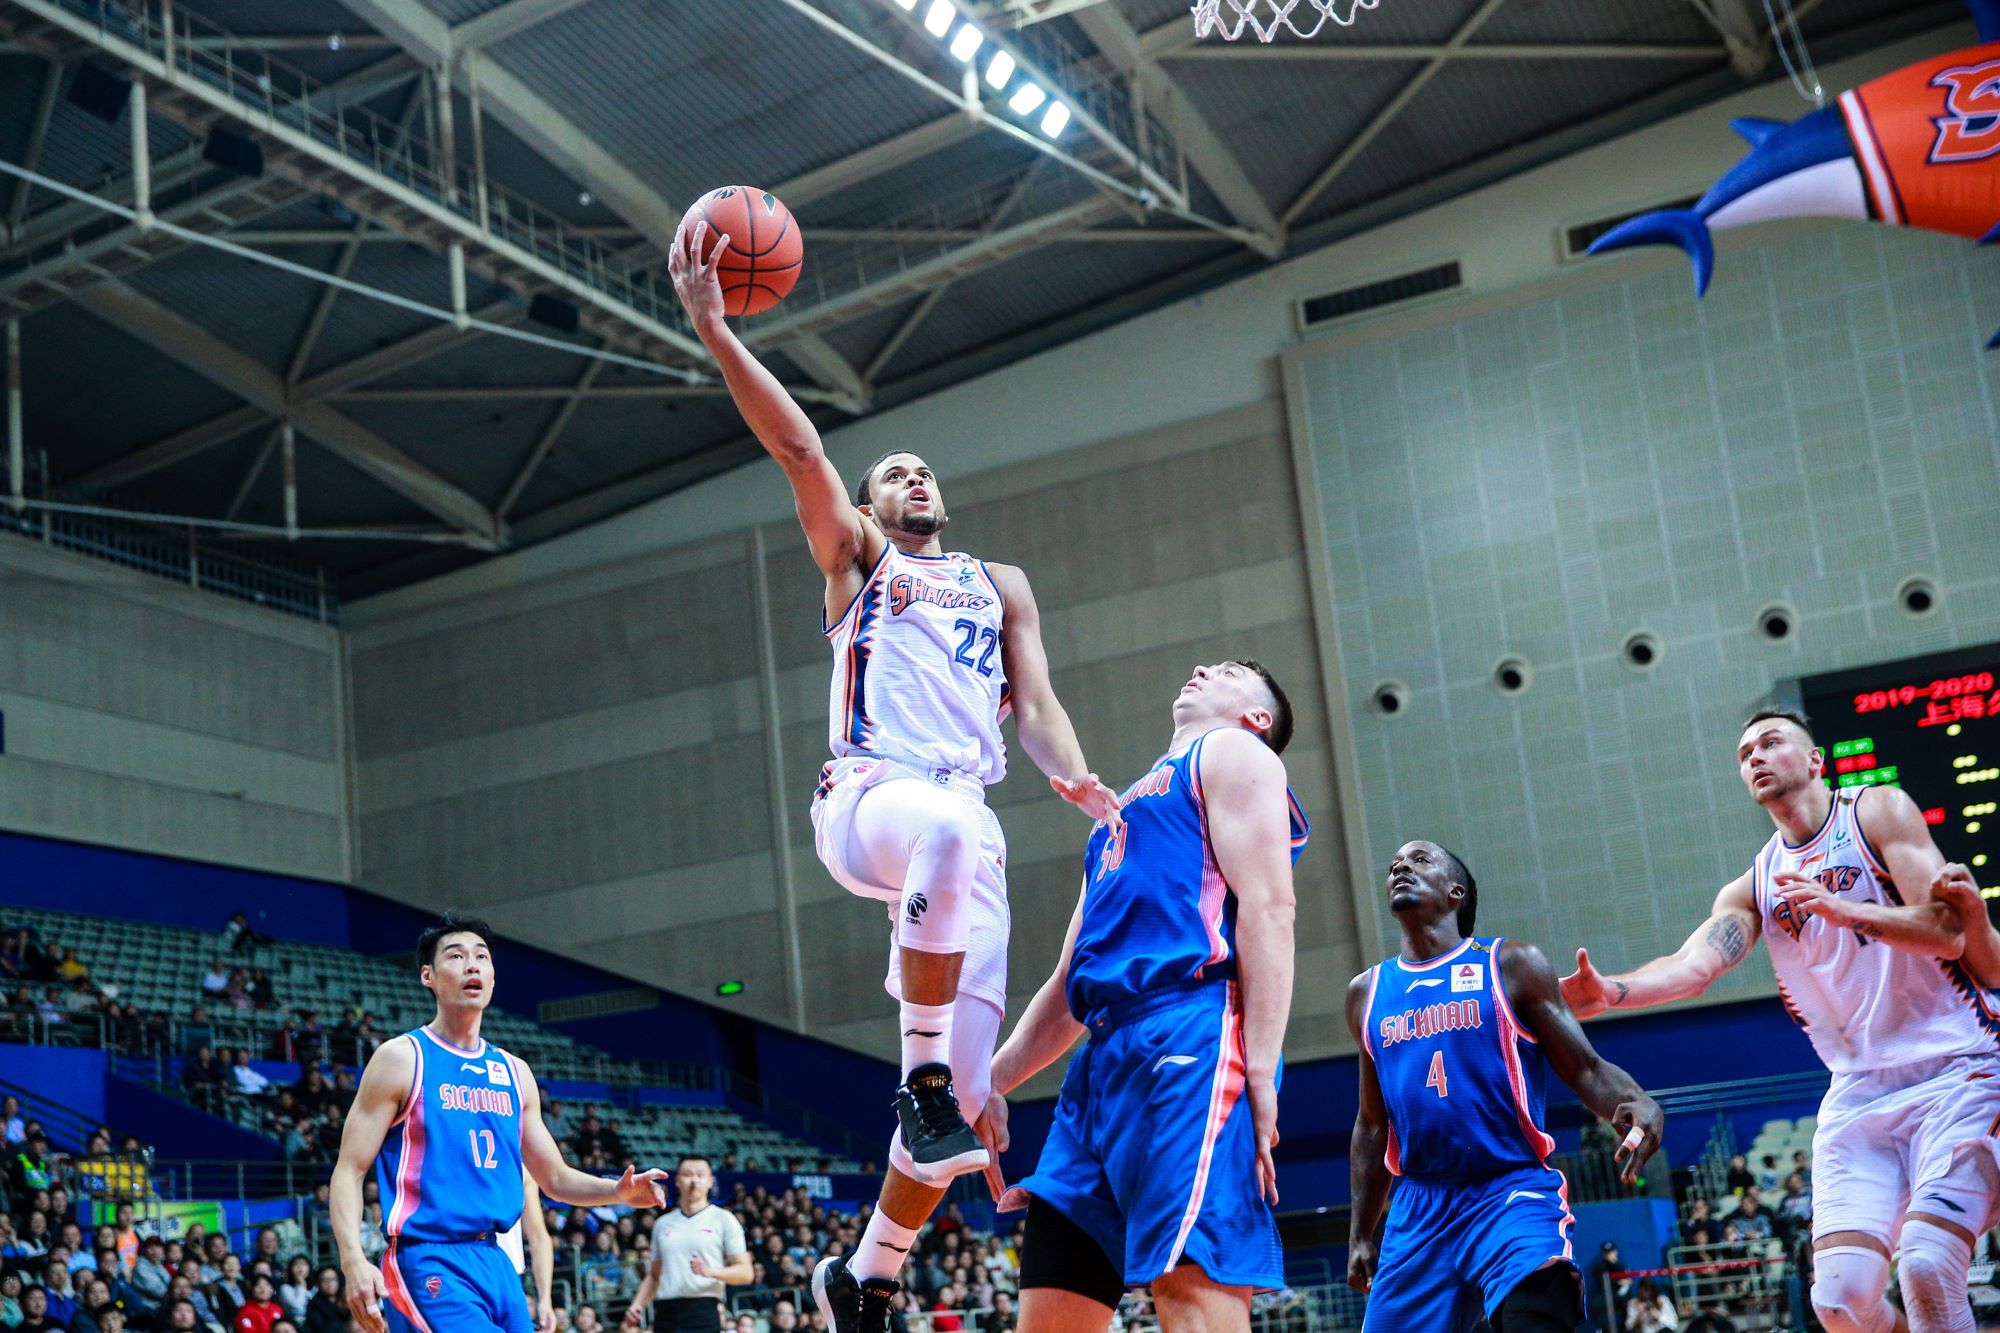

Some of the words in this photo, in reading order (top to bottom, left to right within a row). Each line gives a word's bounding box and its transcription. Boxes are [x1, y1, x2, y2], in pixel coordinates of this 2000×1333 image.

[890, 573, 995, 617] SHARKS
[954, 617, 997, 679] 22
[1380, 998, 1483, 1049] SICHUAN
[1425, 1050, 1448, 1099] 4
[439, 1083, 514, 1117] SICHUAN
[468, 1129, 498, 1169] 12
